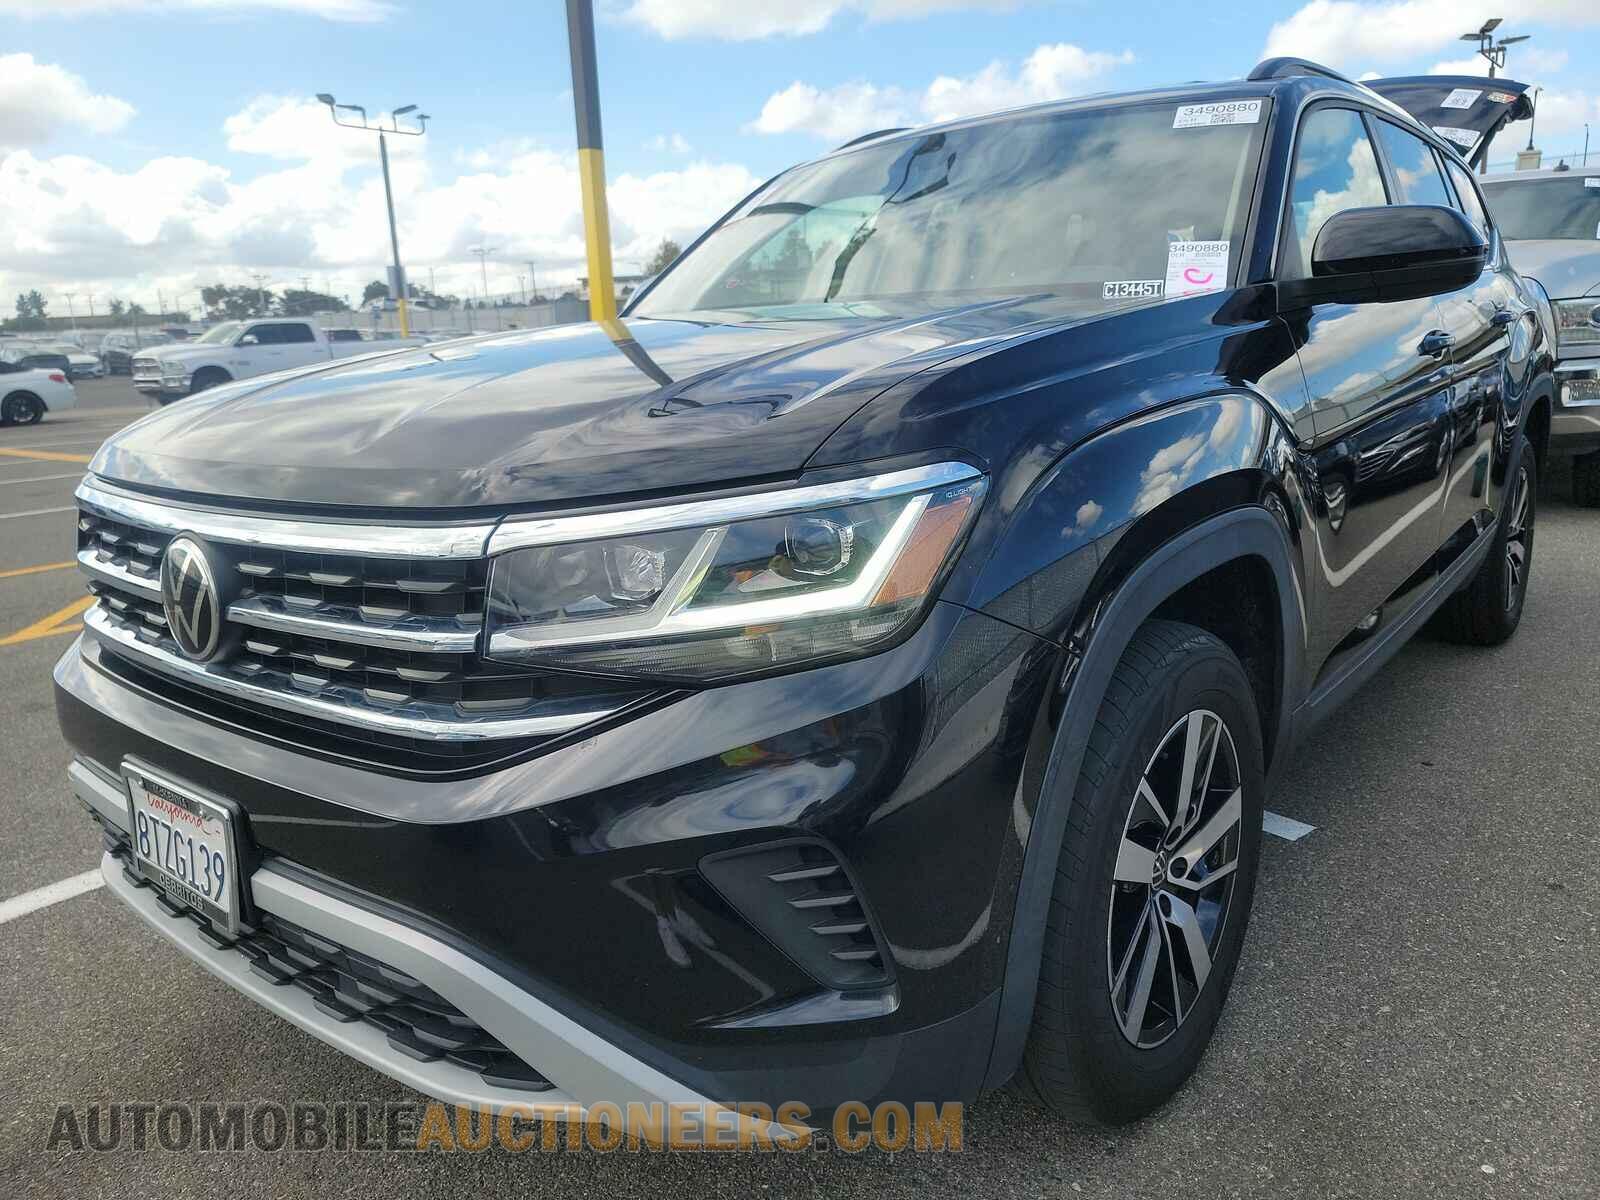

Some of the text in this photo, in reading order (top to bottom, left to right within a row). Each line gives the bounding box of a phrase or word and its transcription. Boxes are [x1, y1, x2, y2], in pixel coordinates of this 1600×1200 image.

[1184, 102, 1258, 116] 3490880
[1170, 243, 1228, 252] 3490880
[137, 810, 224, 902] 8TZG139
[159, 874, 204, 910] CERRITOS
